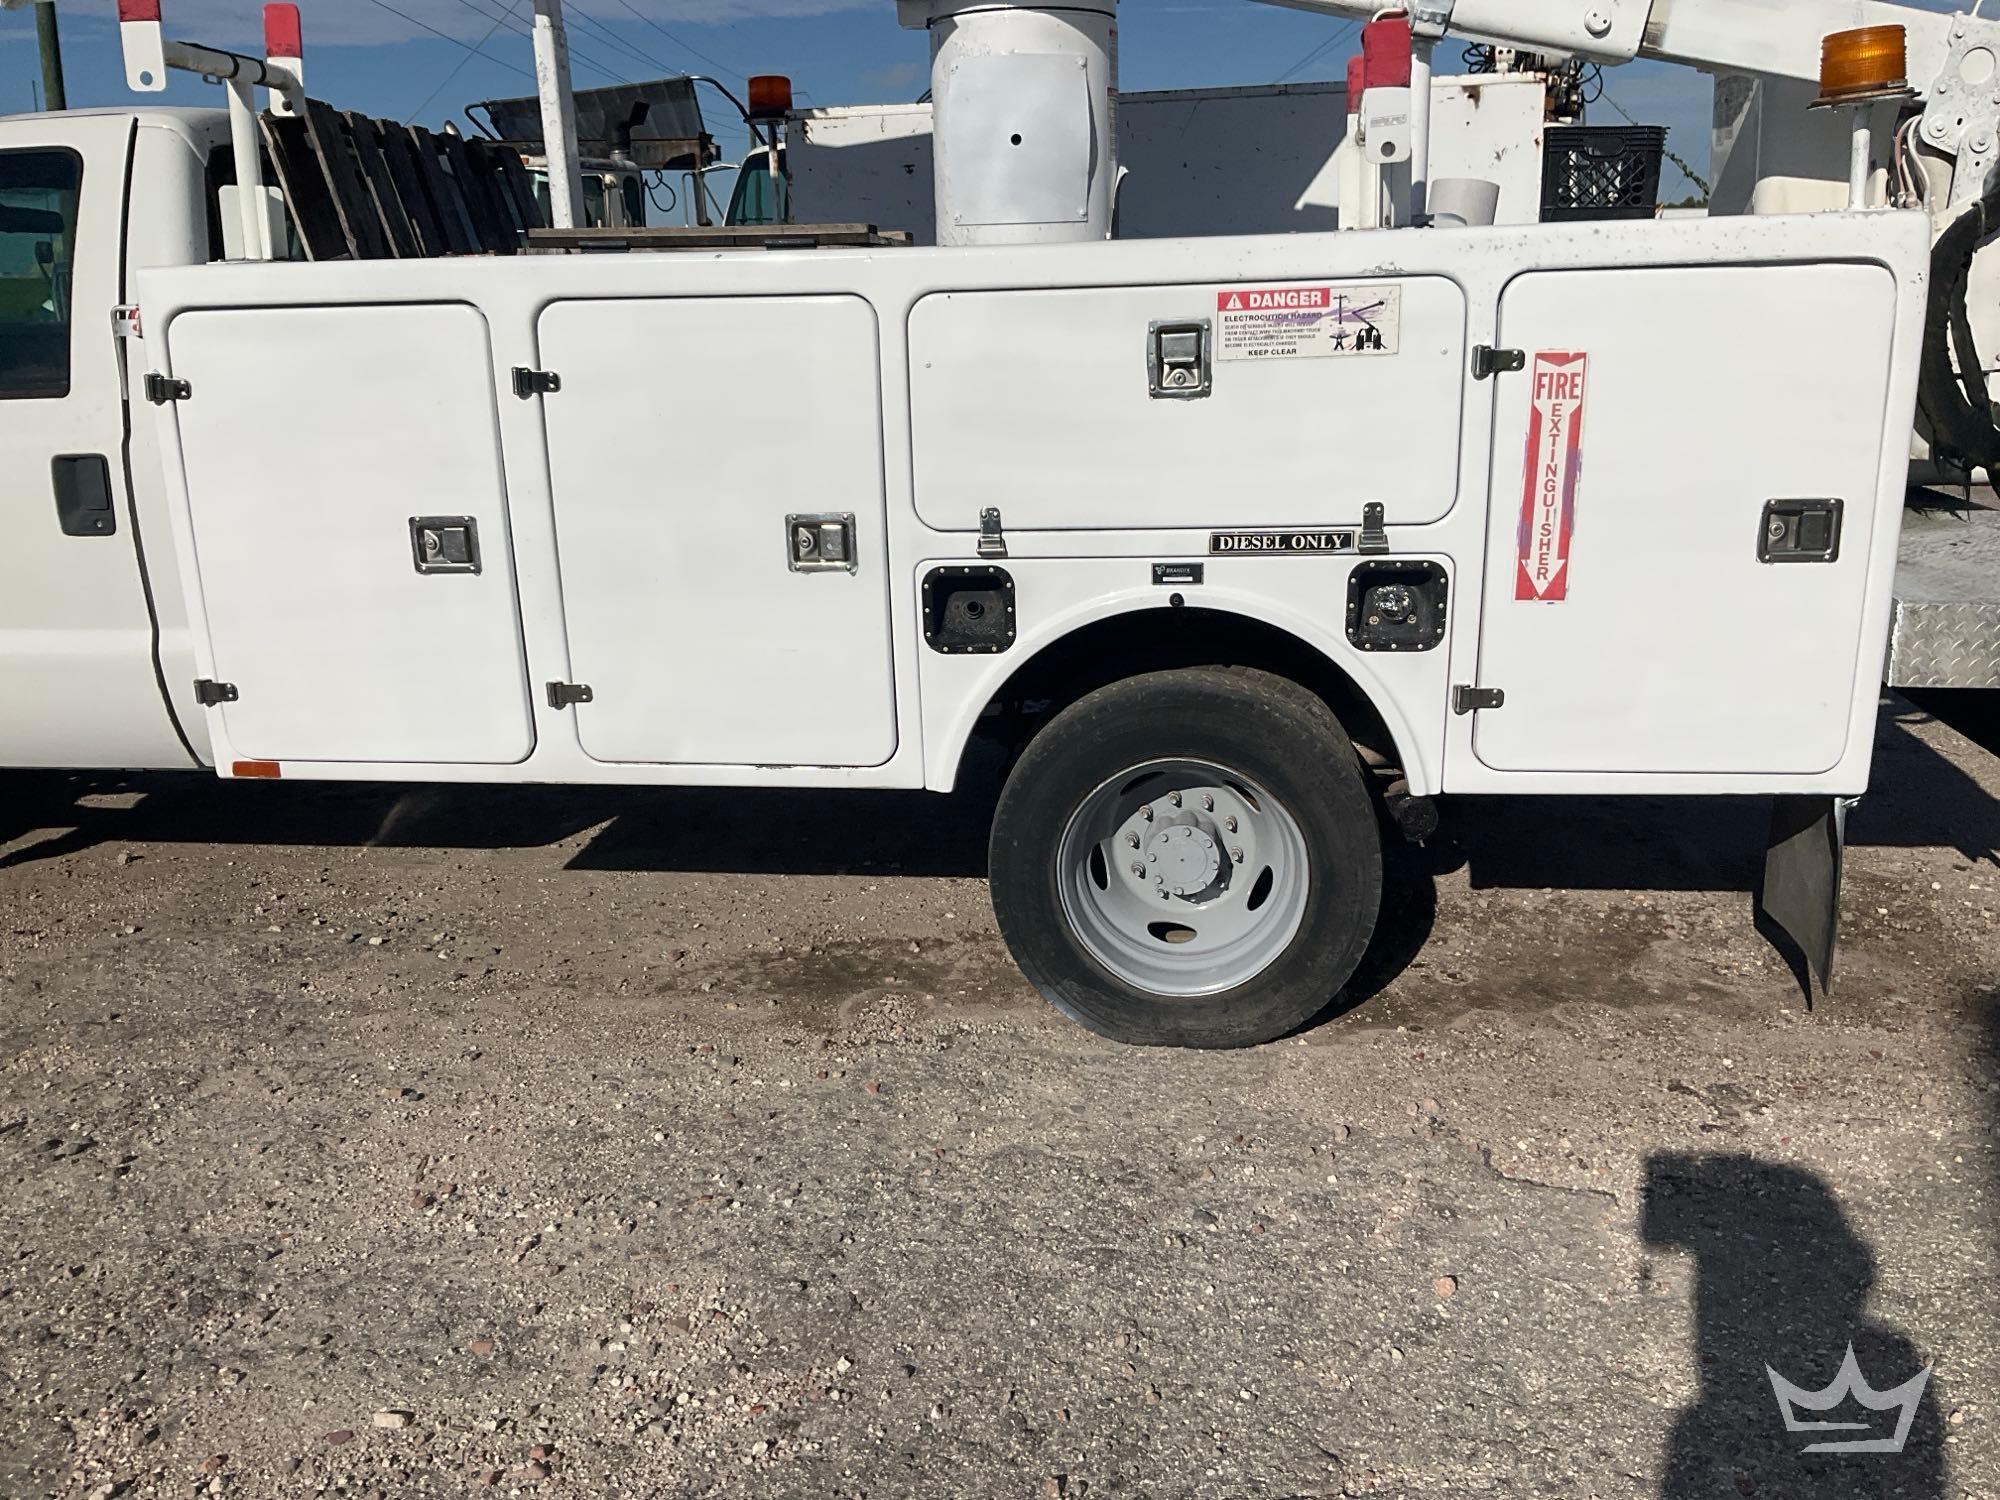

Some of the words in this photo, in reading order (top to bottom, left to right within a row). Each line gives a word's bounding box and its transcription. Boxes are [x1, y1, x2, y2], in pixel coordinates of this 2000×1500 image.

[1249, 291, 1322, 308] DANGER
[1224, 313, 1289, 322] ELECTROCUTION
[1290, 312, 1322, 320] HAZARD
[1535, 372, 1581, 400] FIRE
[1537, 403, 1563, 581] EXTINGUISHER
[1218, 535, 1286, 551] DIESEL
[1291, 534, 1345, 550] ONLY
